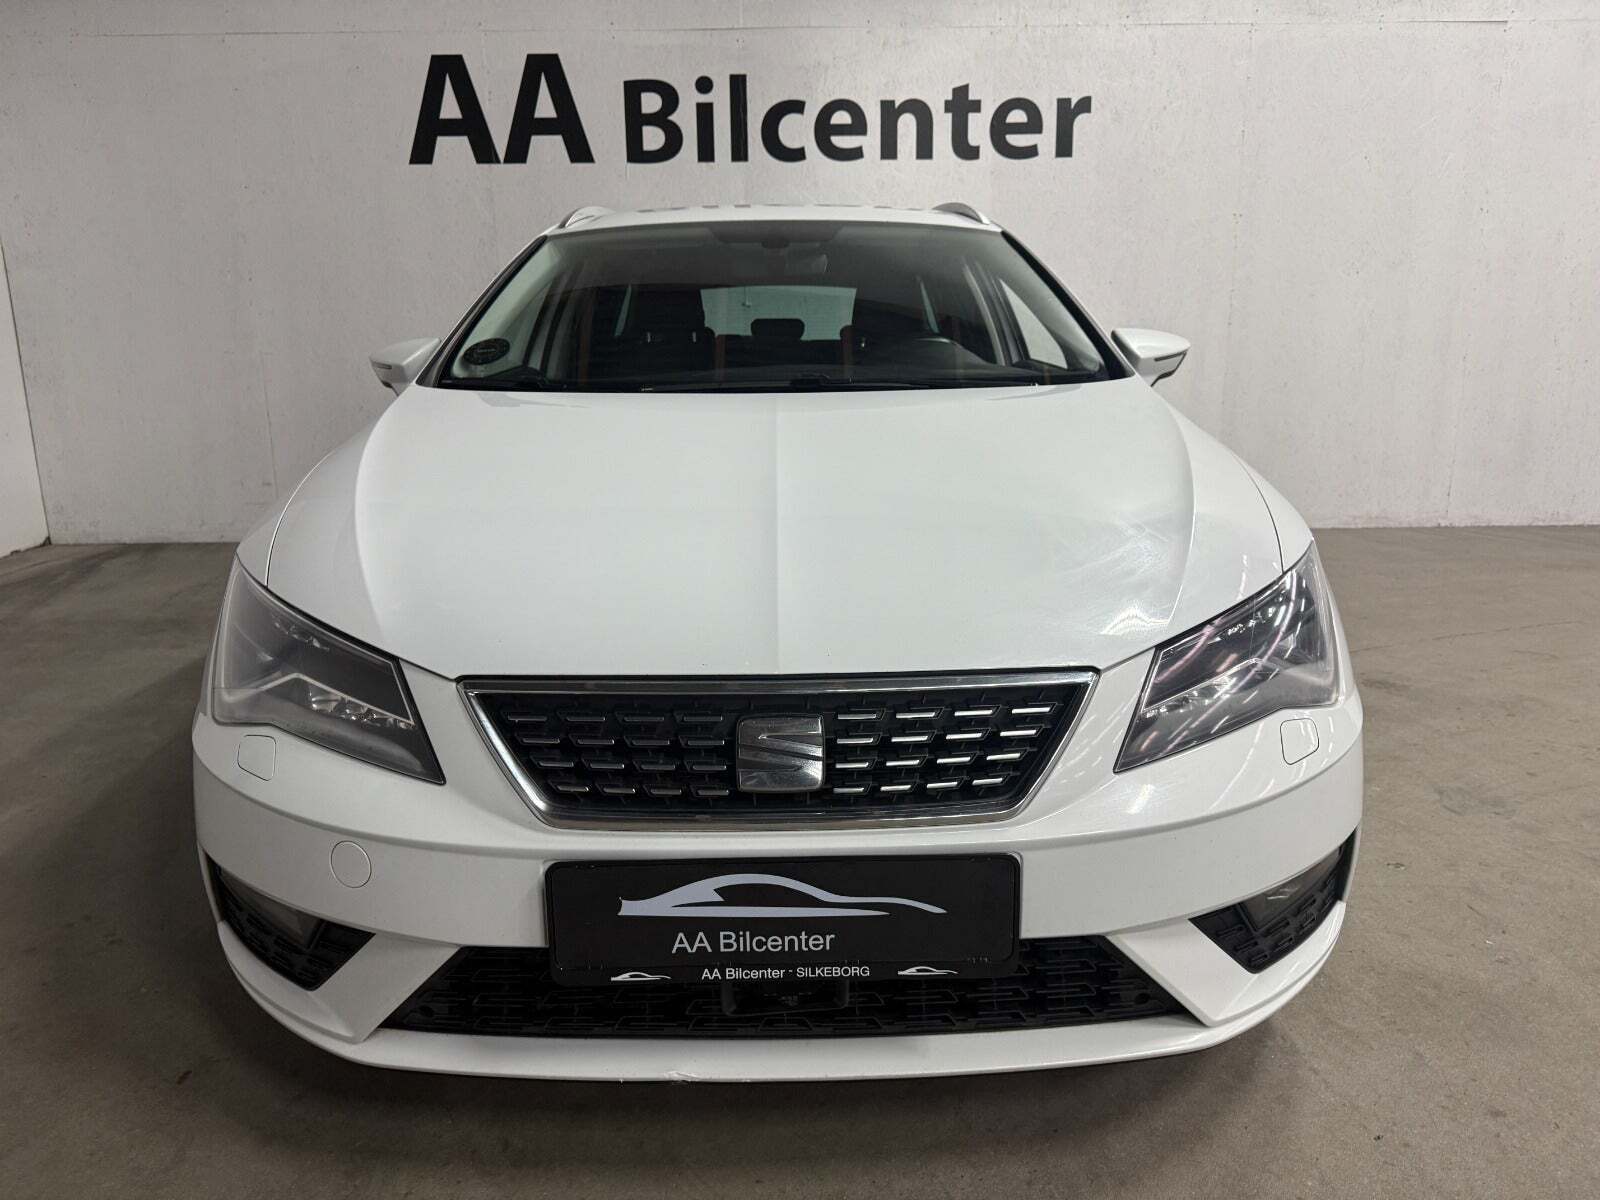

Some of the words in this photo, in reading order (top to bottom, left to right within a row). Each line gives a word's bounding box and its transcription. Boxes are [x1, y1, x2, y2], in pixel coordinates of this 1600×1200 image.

[408, 53, 596, 165] AA
[623, 73, 1092, 164] Bilcenter
[671, 931, 713, 954] AA
[718, 930, 836, 954] Bilcenter
[701, 967, 722, 981] AA
[725, 967, 786, 980] Bilcenter
[796, 966, 871, 979] SILKEBORG
